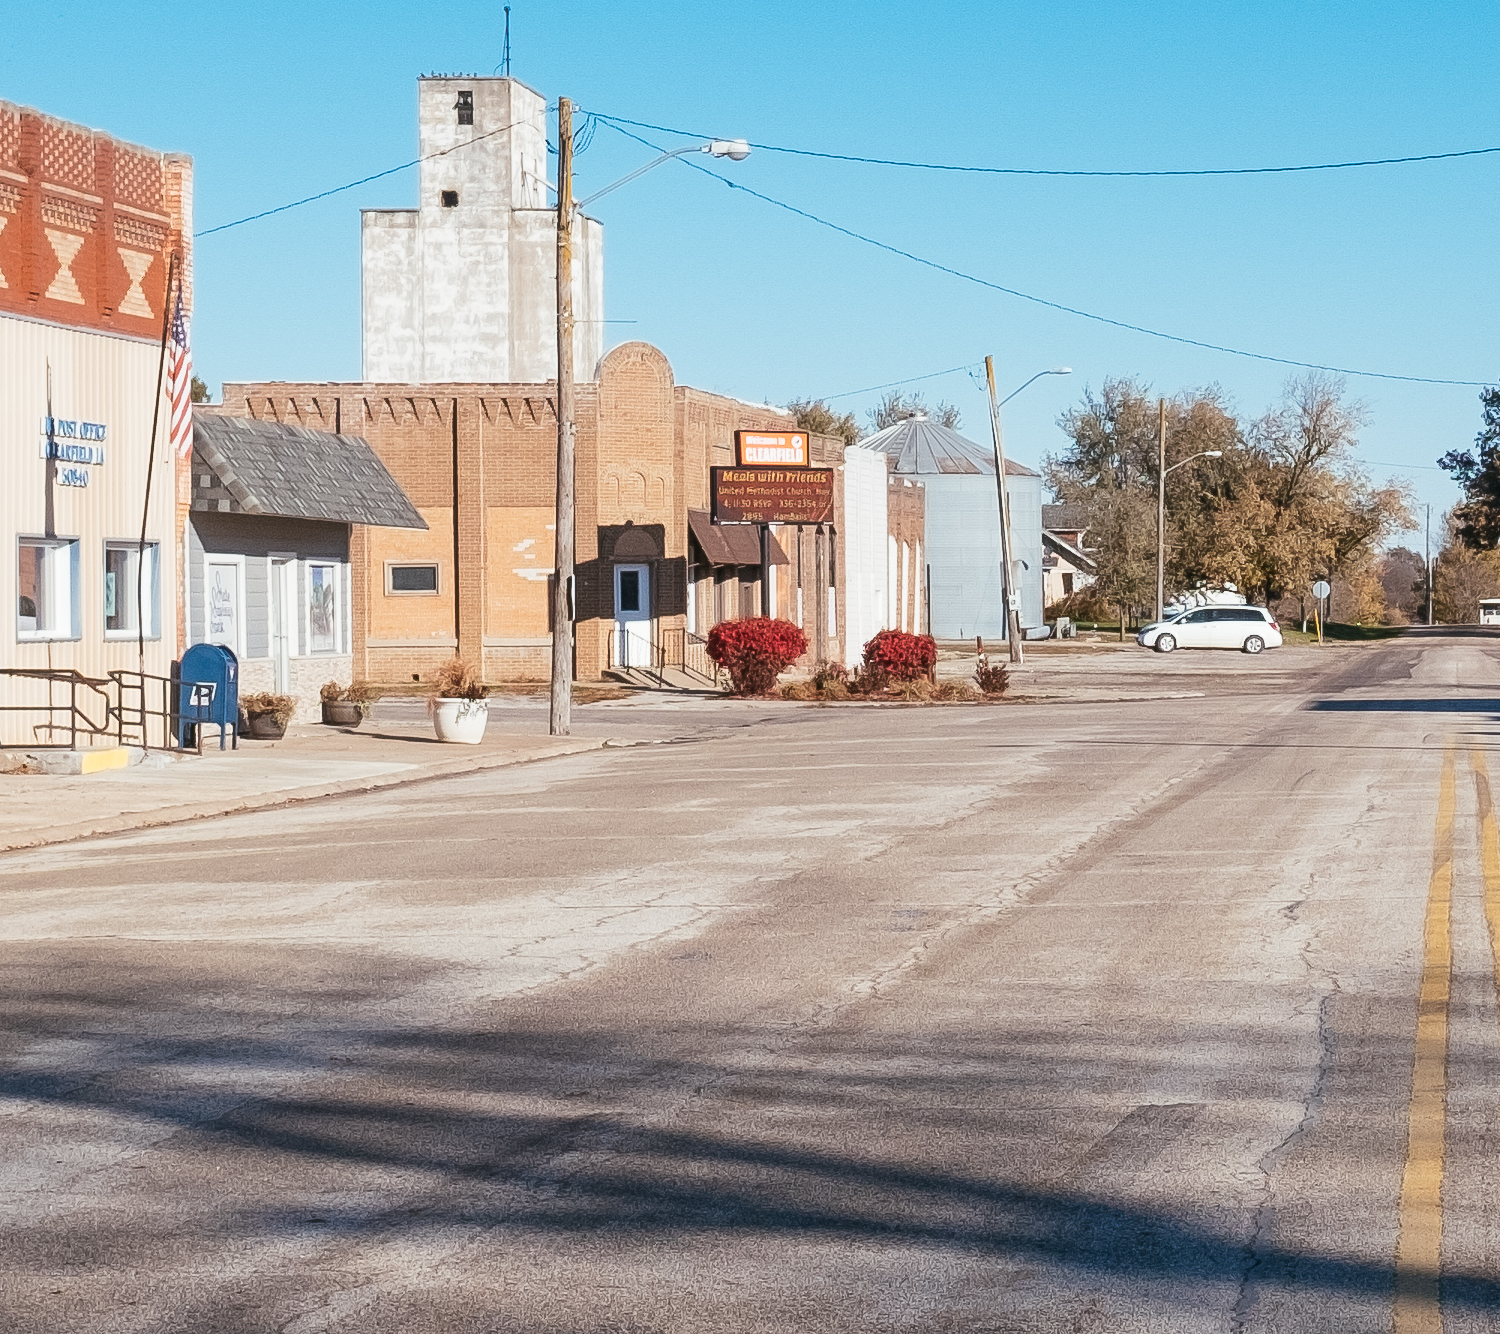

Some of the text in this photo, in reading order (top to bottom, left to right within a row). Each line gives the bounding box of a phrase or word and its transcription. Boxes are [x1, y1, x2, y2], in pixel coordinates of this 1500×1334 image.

[58, 419, 76, 437] POST
[80, 422, 107, 441] OFFICE
[46, 440, 92, 462] CLEARFIELD
[745, 447, 804, 463] CLEARFIELD
[62, 468, 88, 486] 50840
[722, 471, 827, 483] Meals with Friends
[718, 487, 744, 496] United
